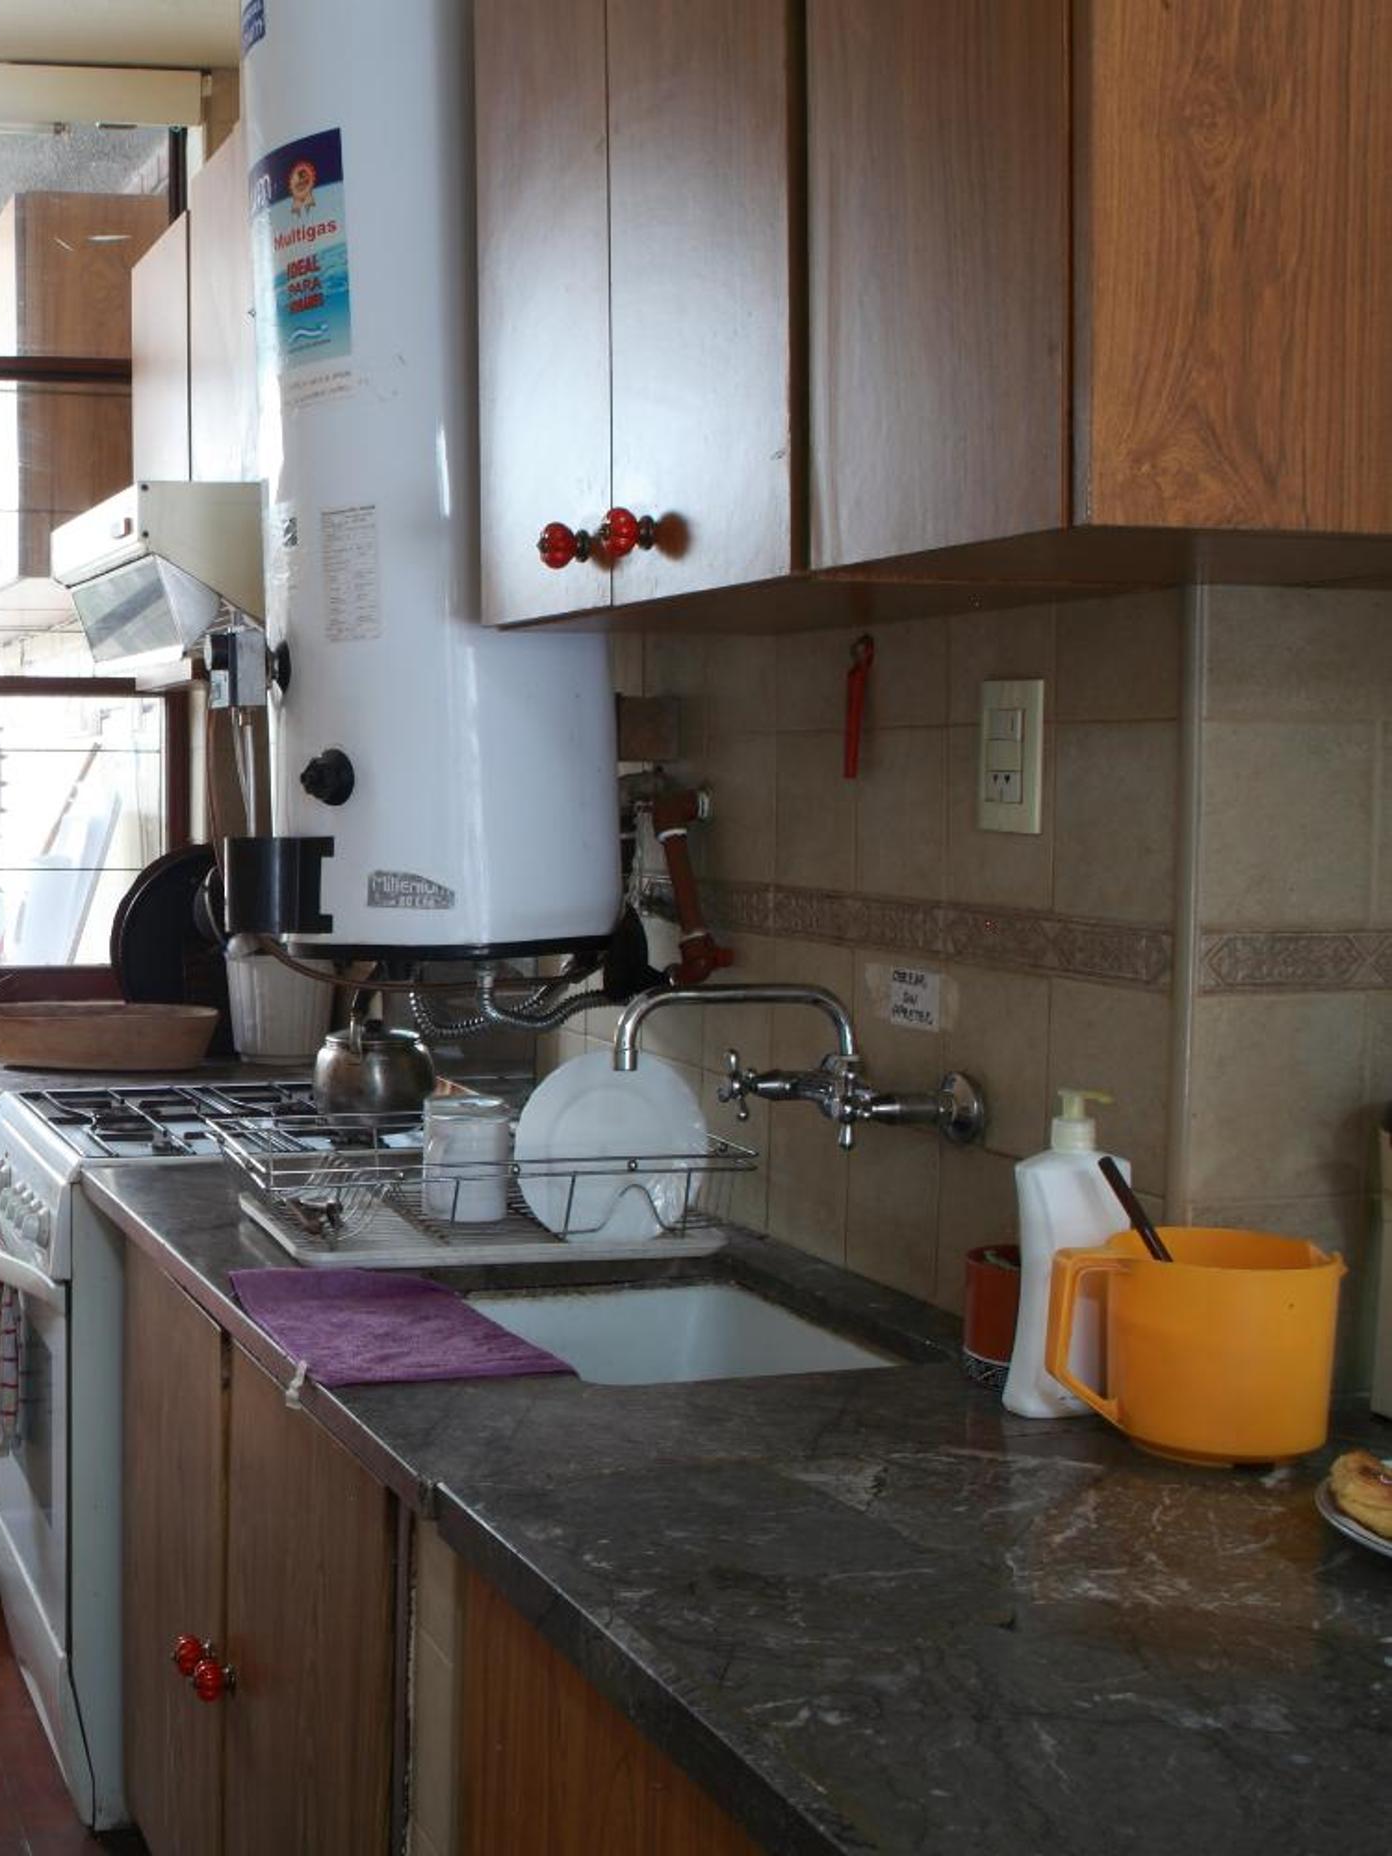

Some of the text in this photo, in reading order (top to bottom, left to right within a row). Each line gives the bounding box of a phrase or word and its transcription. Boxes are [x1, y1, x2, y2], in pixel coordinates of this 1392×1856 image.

[273, 220, 337, 250] Multigas
[287, 254, 321, 281] IDEAL
[288, 277, 322, 294] PARA
